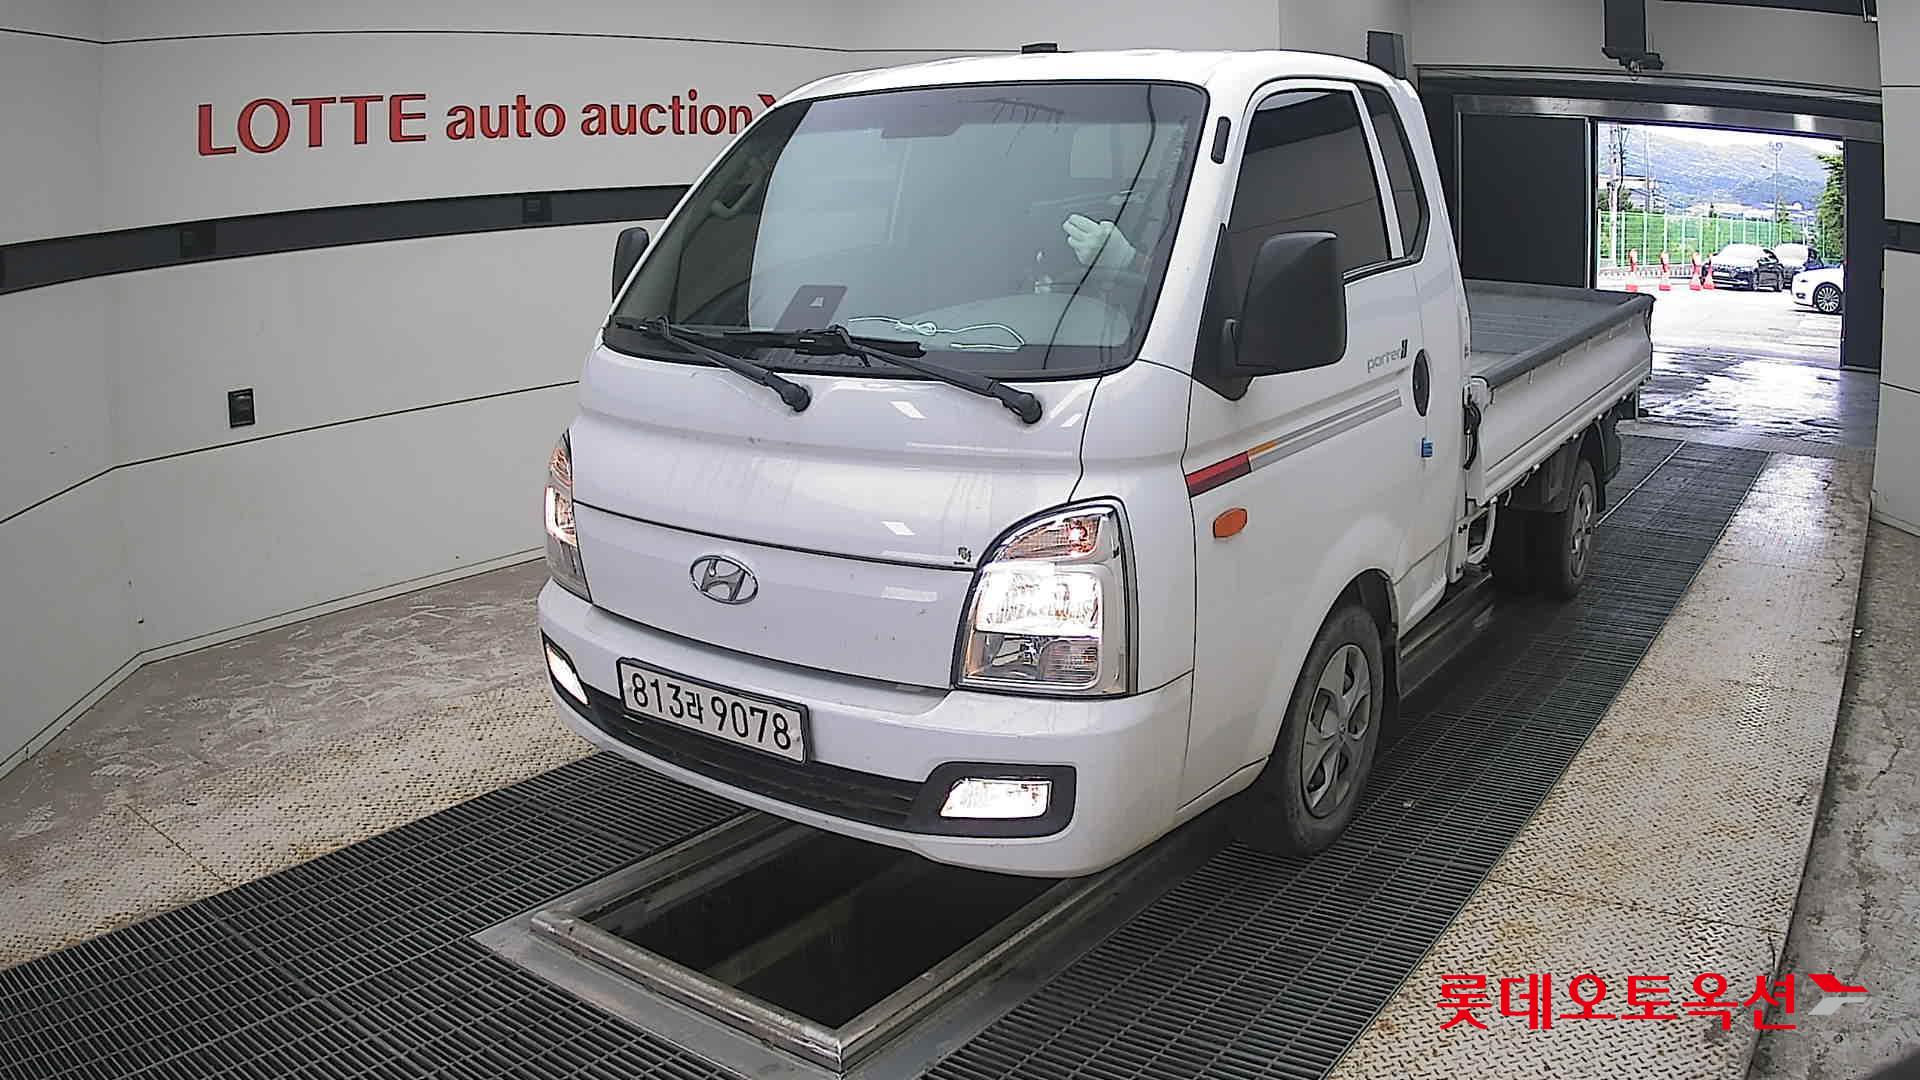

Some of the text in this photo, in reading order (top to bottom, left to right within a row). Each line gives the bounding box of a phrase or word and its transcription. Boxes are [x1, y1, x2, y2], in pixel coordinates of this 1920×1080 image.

[197, 88, 753, 157] LOTTE auto auction
[710, 696, 791, 750] 9078
